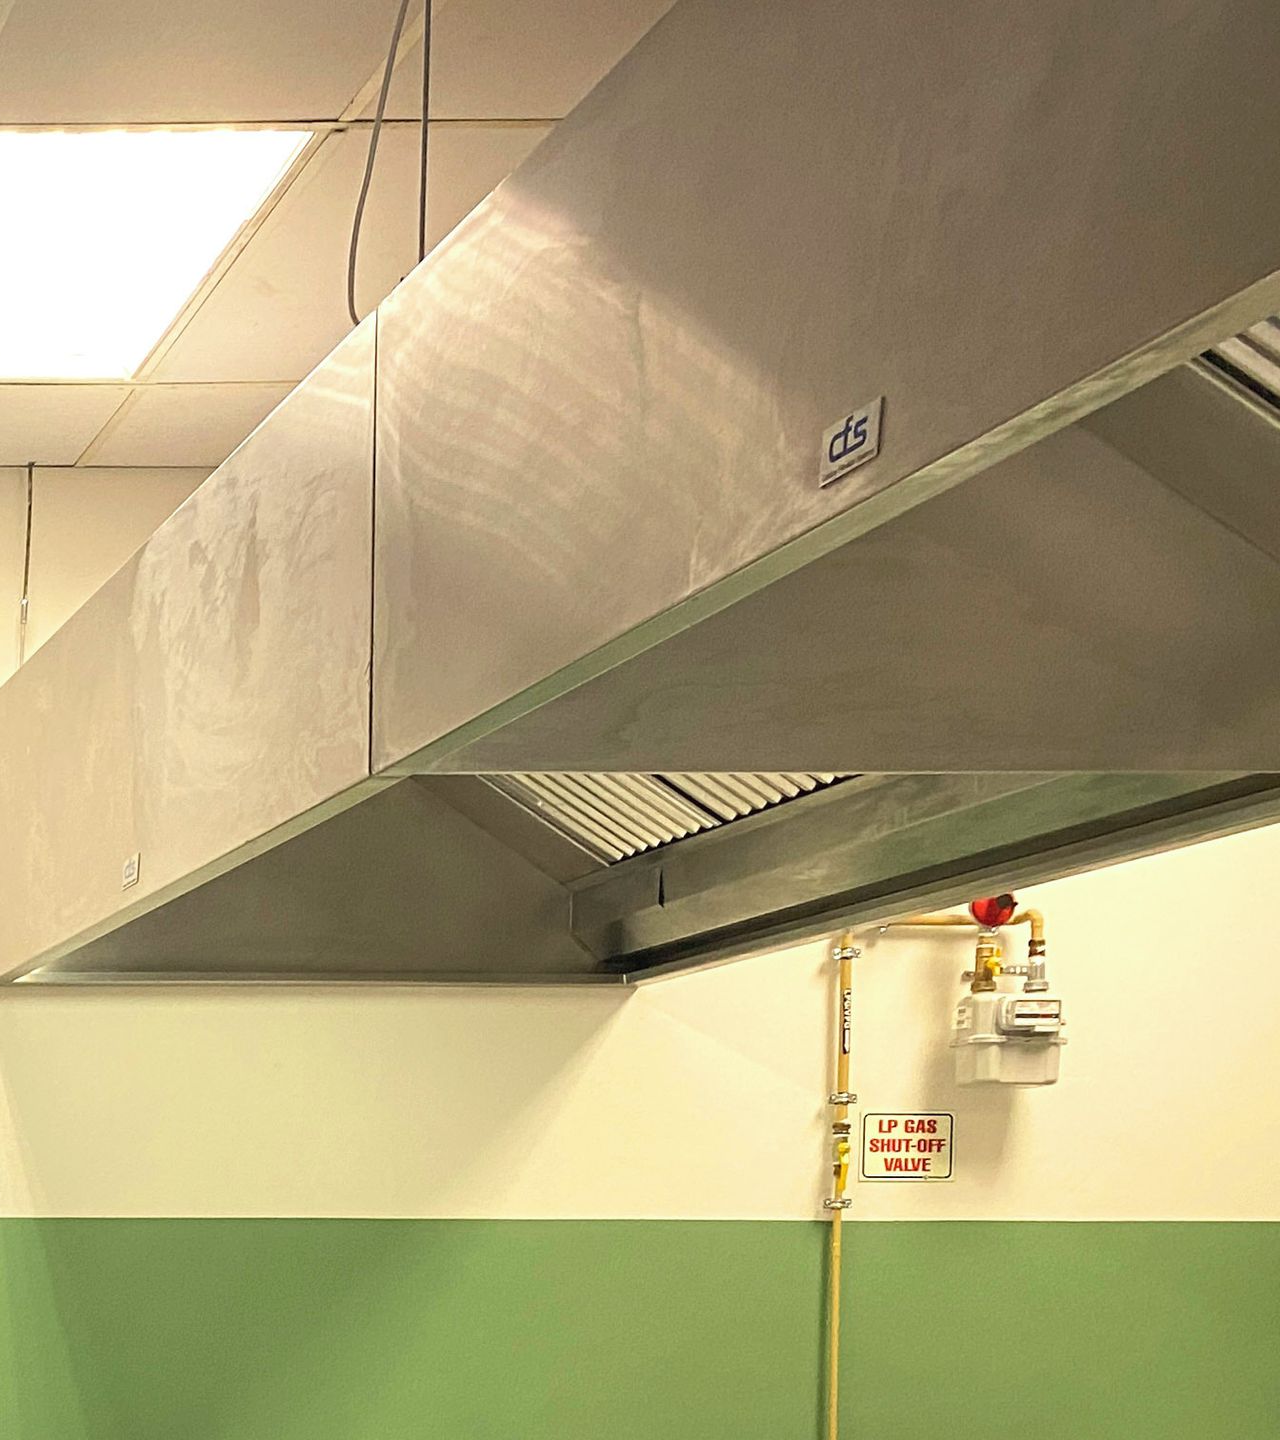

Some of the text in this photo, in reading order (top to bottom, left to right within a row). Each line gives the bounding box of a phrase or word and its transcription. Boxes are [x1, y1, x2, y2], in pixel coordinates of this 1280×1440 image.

[878, 1119, 938, 1134] LP GAS
[869, 1138, 947, 1153] SHUT-OFF
[883, 1157, 932, 1172] VALVE
